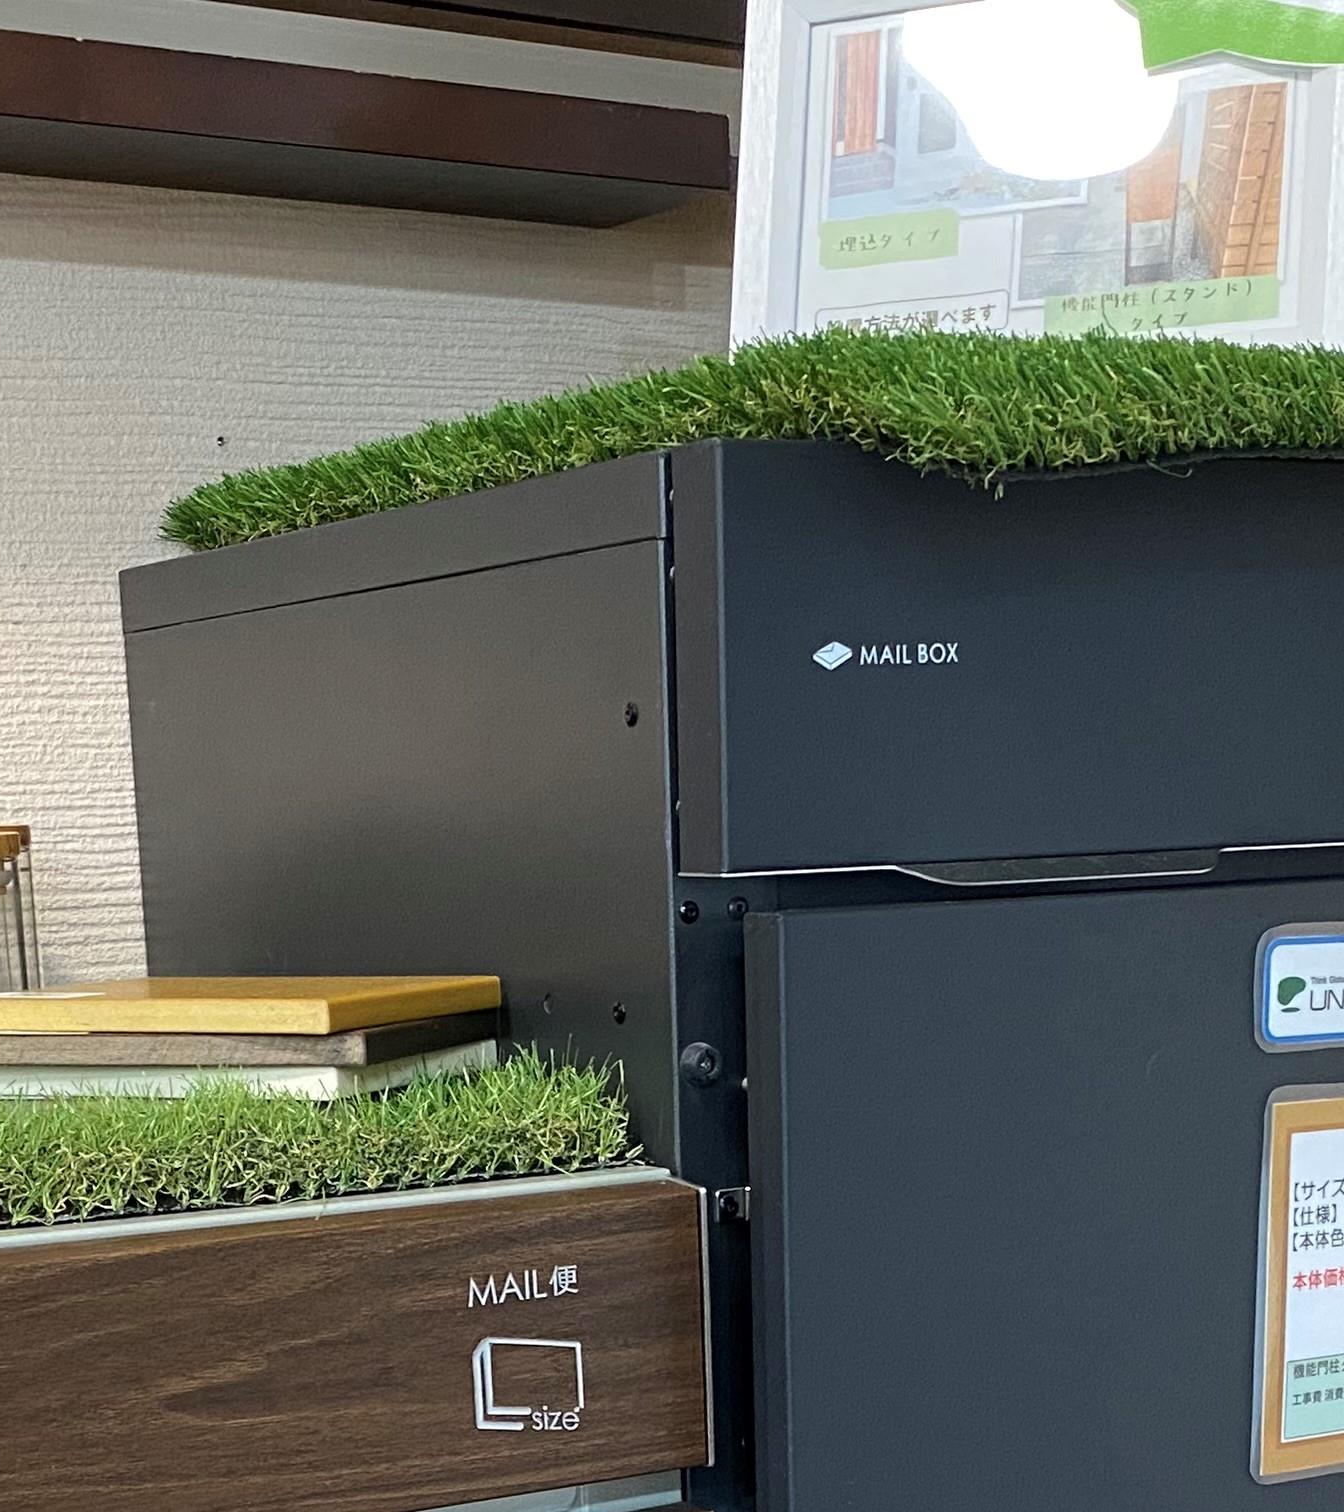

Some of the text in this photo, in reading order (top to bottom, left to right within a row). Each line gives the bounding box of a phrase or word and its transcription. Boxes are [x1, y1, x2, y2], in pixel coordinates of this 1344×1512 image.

[859, 642, 959, 666] MAIL BOX
[468, 1265, 579, 1308] MAIL便
[532, 1405, 580, 1431] size
